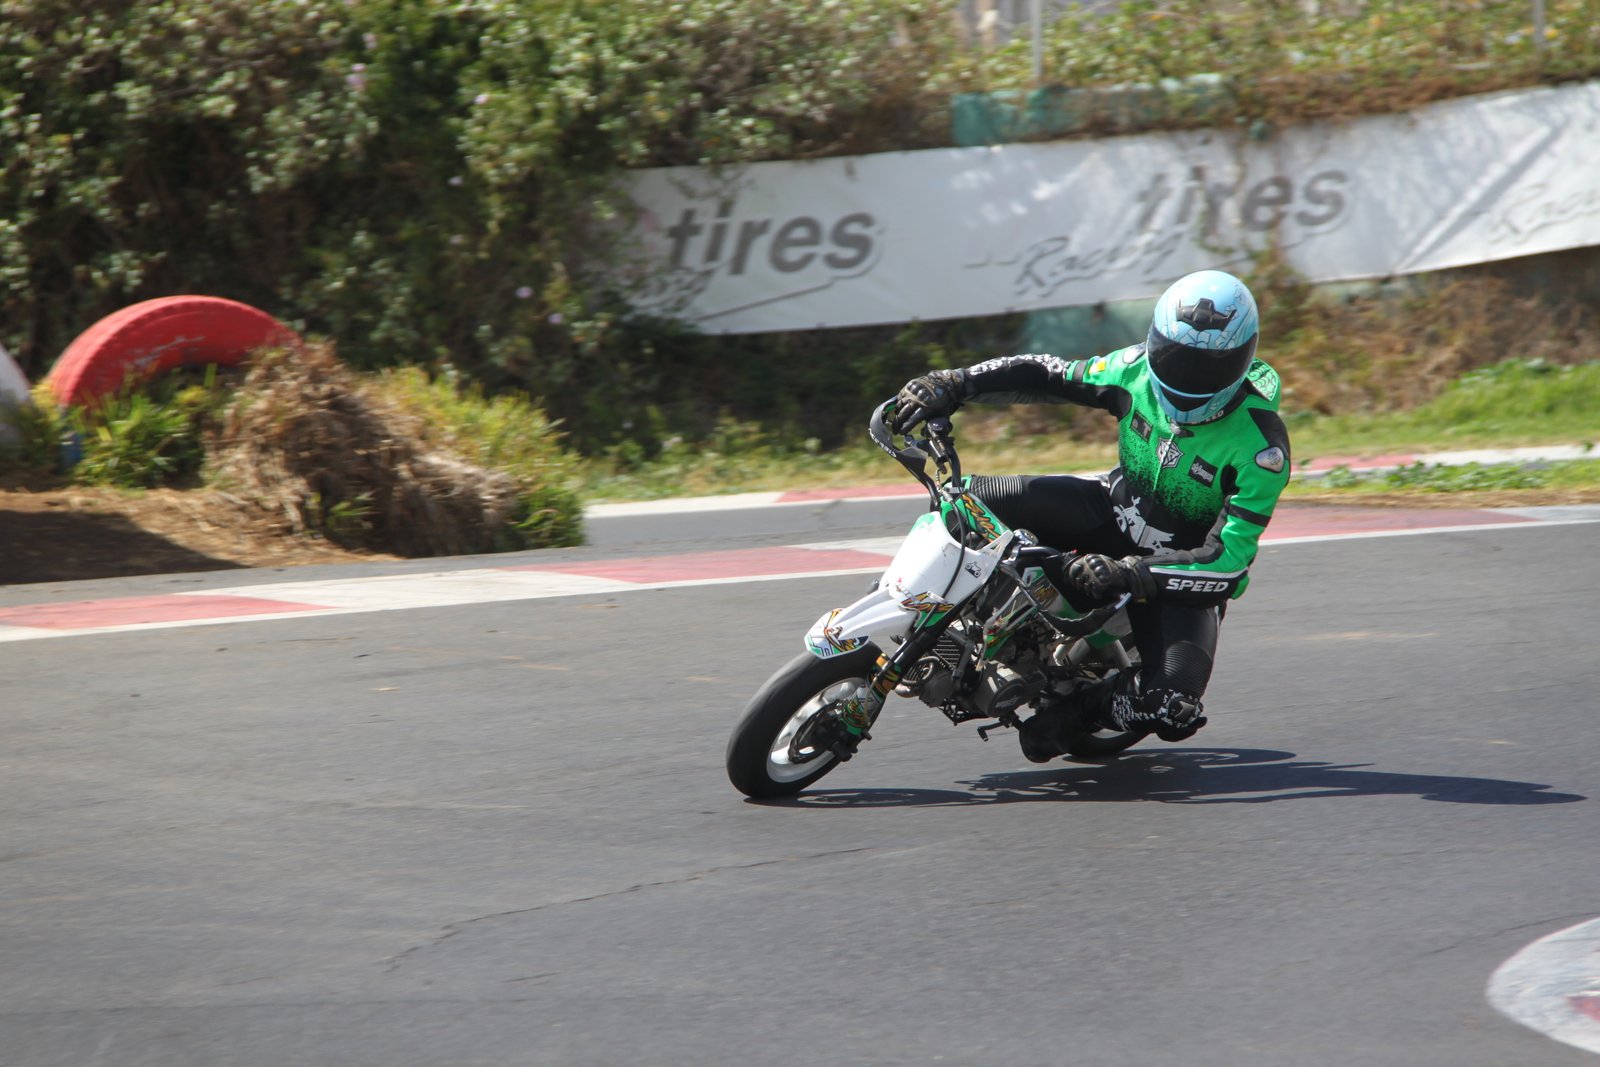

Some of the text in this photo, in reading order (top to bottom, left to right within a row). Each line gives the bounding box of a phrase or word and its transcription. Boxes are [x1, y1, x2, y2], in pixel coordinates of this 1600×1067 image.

[1136, 165, 1348, 237] tires
[667, 200, 876, 275] tires
[1165, 578, 1229, 593] SPEED
